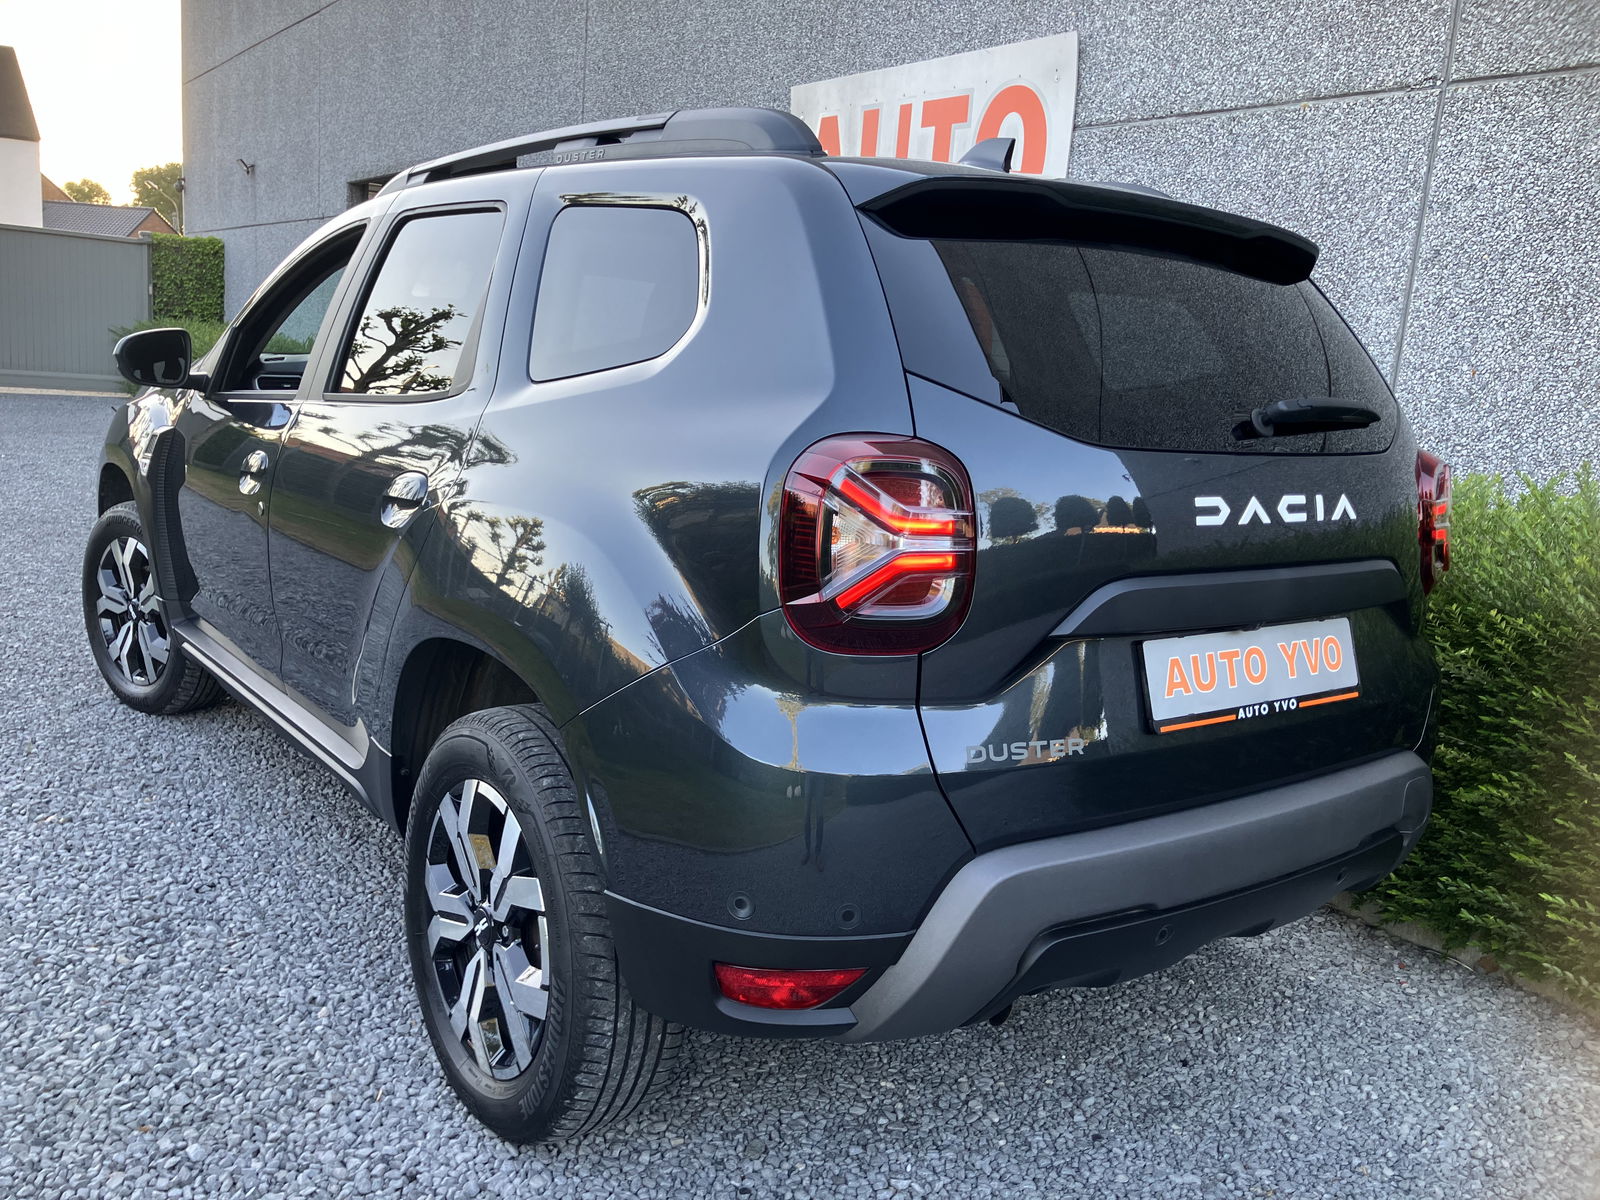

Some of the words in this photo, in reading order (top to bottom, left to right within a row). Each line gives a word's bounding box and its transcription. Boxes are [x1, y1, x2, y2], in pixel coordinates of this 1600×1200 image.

[556, 149, 606, 164] DUSTER
[1194, 493, 1357, 526] DACIA
[1164, 645, 1268, 698] AUTO
[1277, 635, 1343, 679] YVO
[1237, 702, 1269, 720] AUTO
[1274, 698, 1298, 713] YVO
[966, 738, 1085, 764] DUSTER
